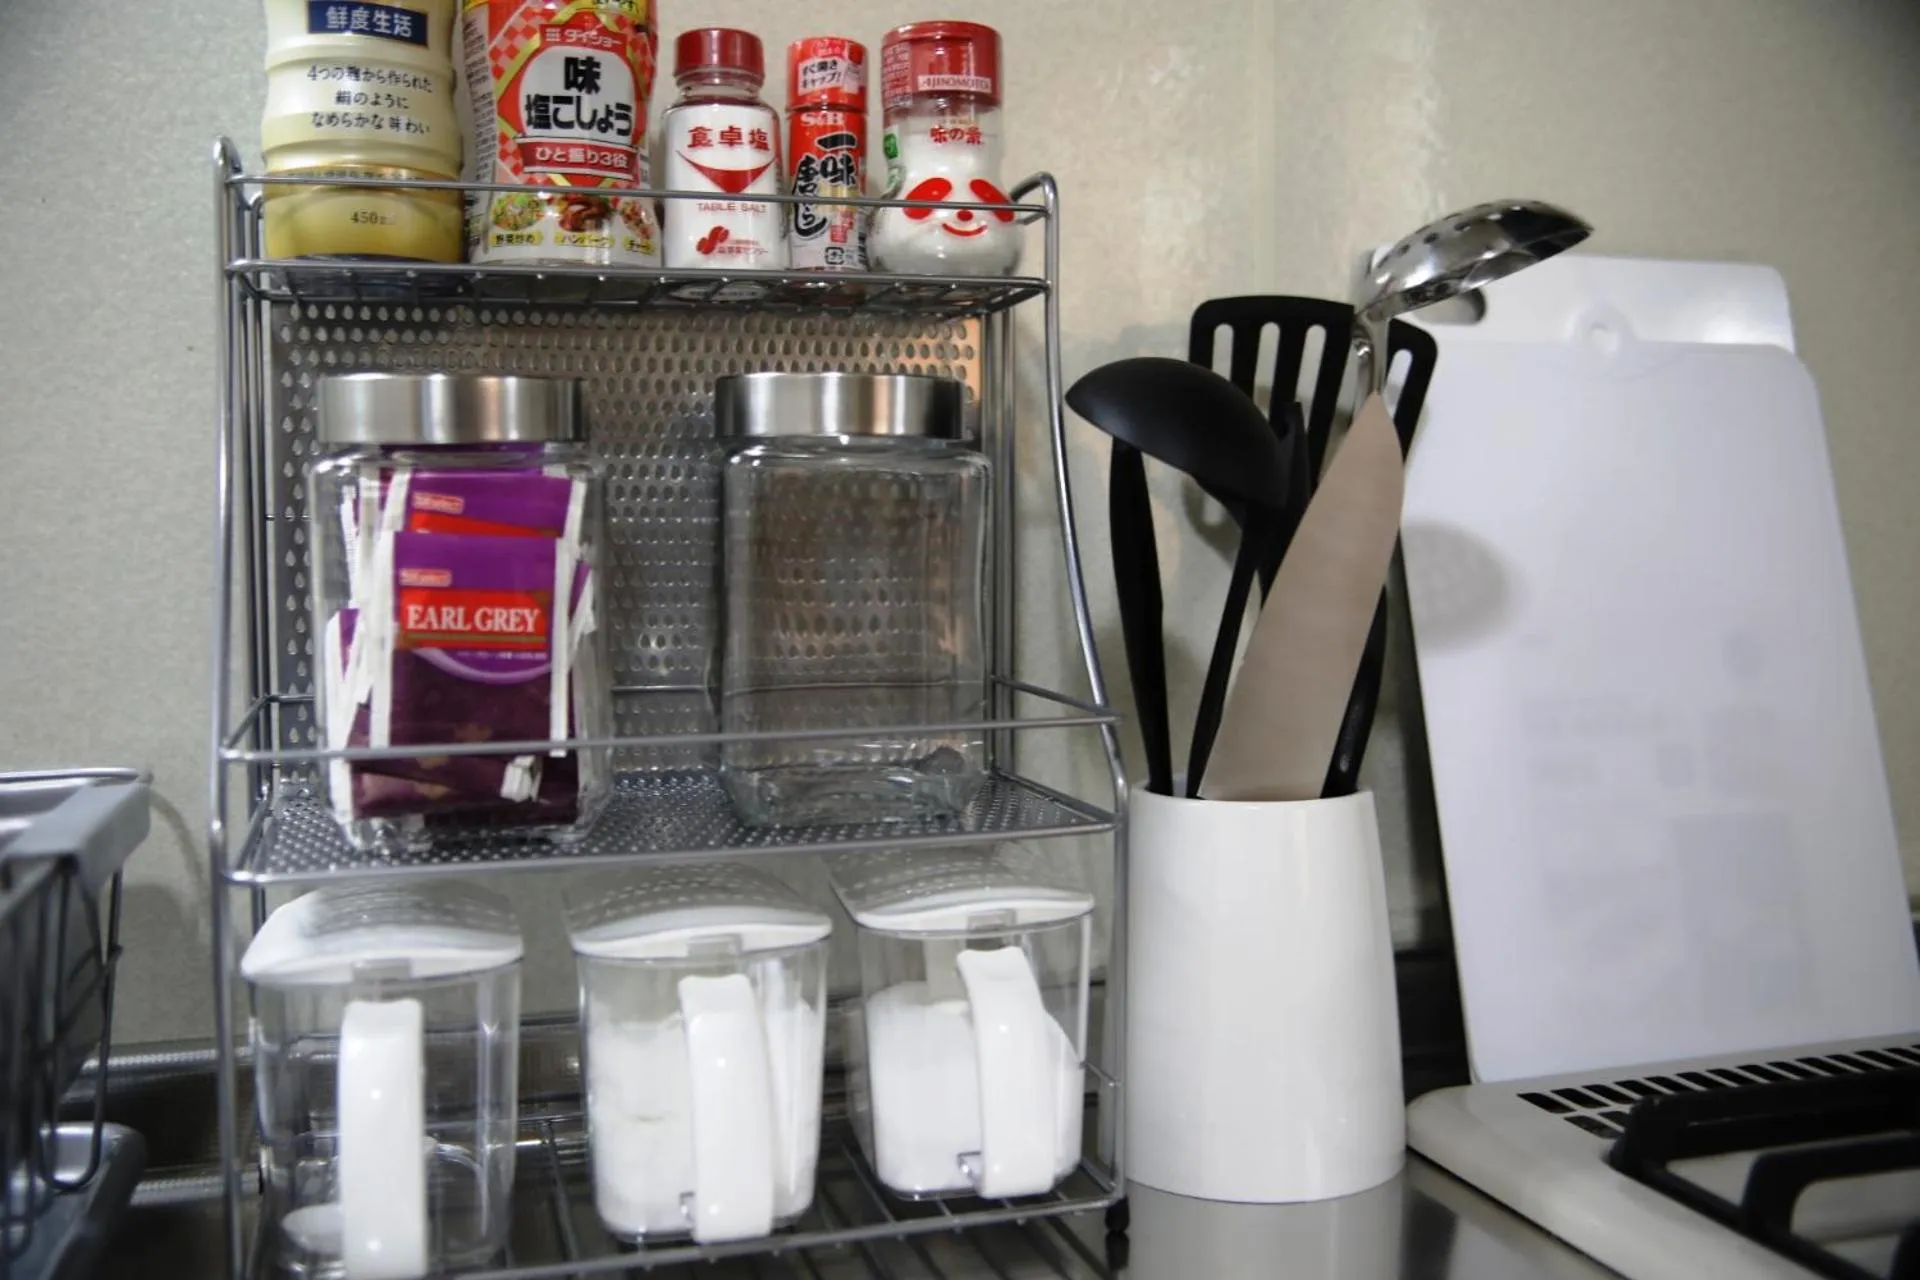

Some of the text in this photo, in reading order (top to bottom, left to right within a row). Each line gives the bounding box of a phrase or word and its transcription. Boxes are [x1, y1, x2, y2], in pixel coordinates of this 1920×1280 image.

[325, 6, 413, 38] 鮮度生活
[563, 26, 622, 48] ダイショー
[564, 57, 602, 94] 味
[525, 94, 633, 137] 塩こしょう
[687, 125, 770, 151] 食卓塩
[930, 125, 982, 145] 味の素
[816, 131, 858, 186] 一味
[696, 202, 768, 213] TABLE SALT
[407, 604, 541, 633] EARL GREY
